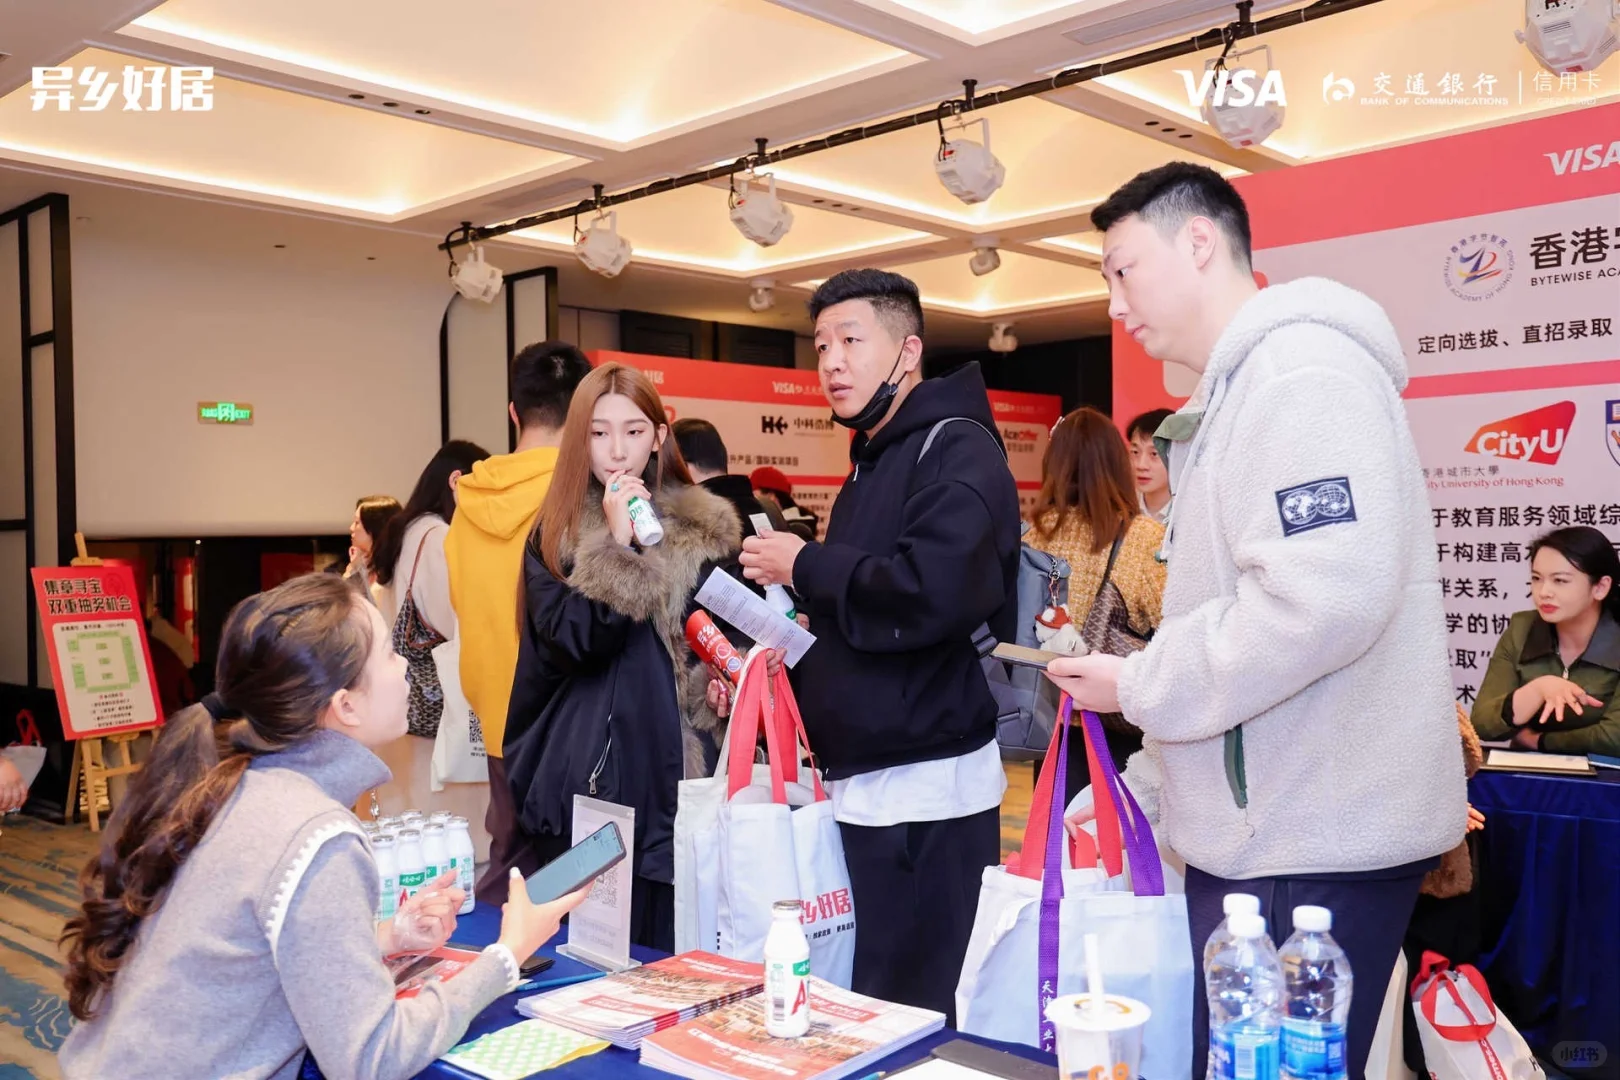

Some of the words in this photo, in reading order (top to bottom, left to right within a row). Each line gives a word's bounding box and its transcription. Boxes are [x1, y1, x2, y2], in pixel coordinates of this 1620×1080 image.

[1542, 140, 1620, 176] VISA
[1531, 270, 1592, 287] BYTEWISE
[1417, 317, 1613, 355] 定向选拔、直招录取
[1476, 428, 1565, 462] CityU
[1441, 476, 1490, 491] University
[1493, 476, 1504, 487] of
[1506, 476, 1534, 488] Hong
[1535, 475, 1564, 487] Kong
[43, 577, 103, 596] 集章寻宝
[46, 595, 132, 616] 双重抽奖机会
[799, 887, 852, 925] 乡好居
